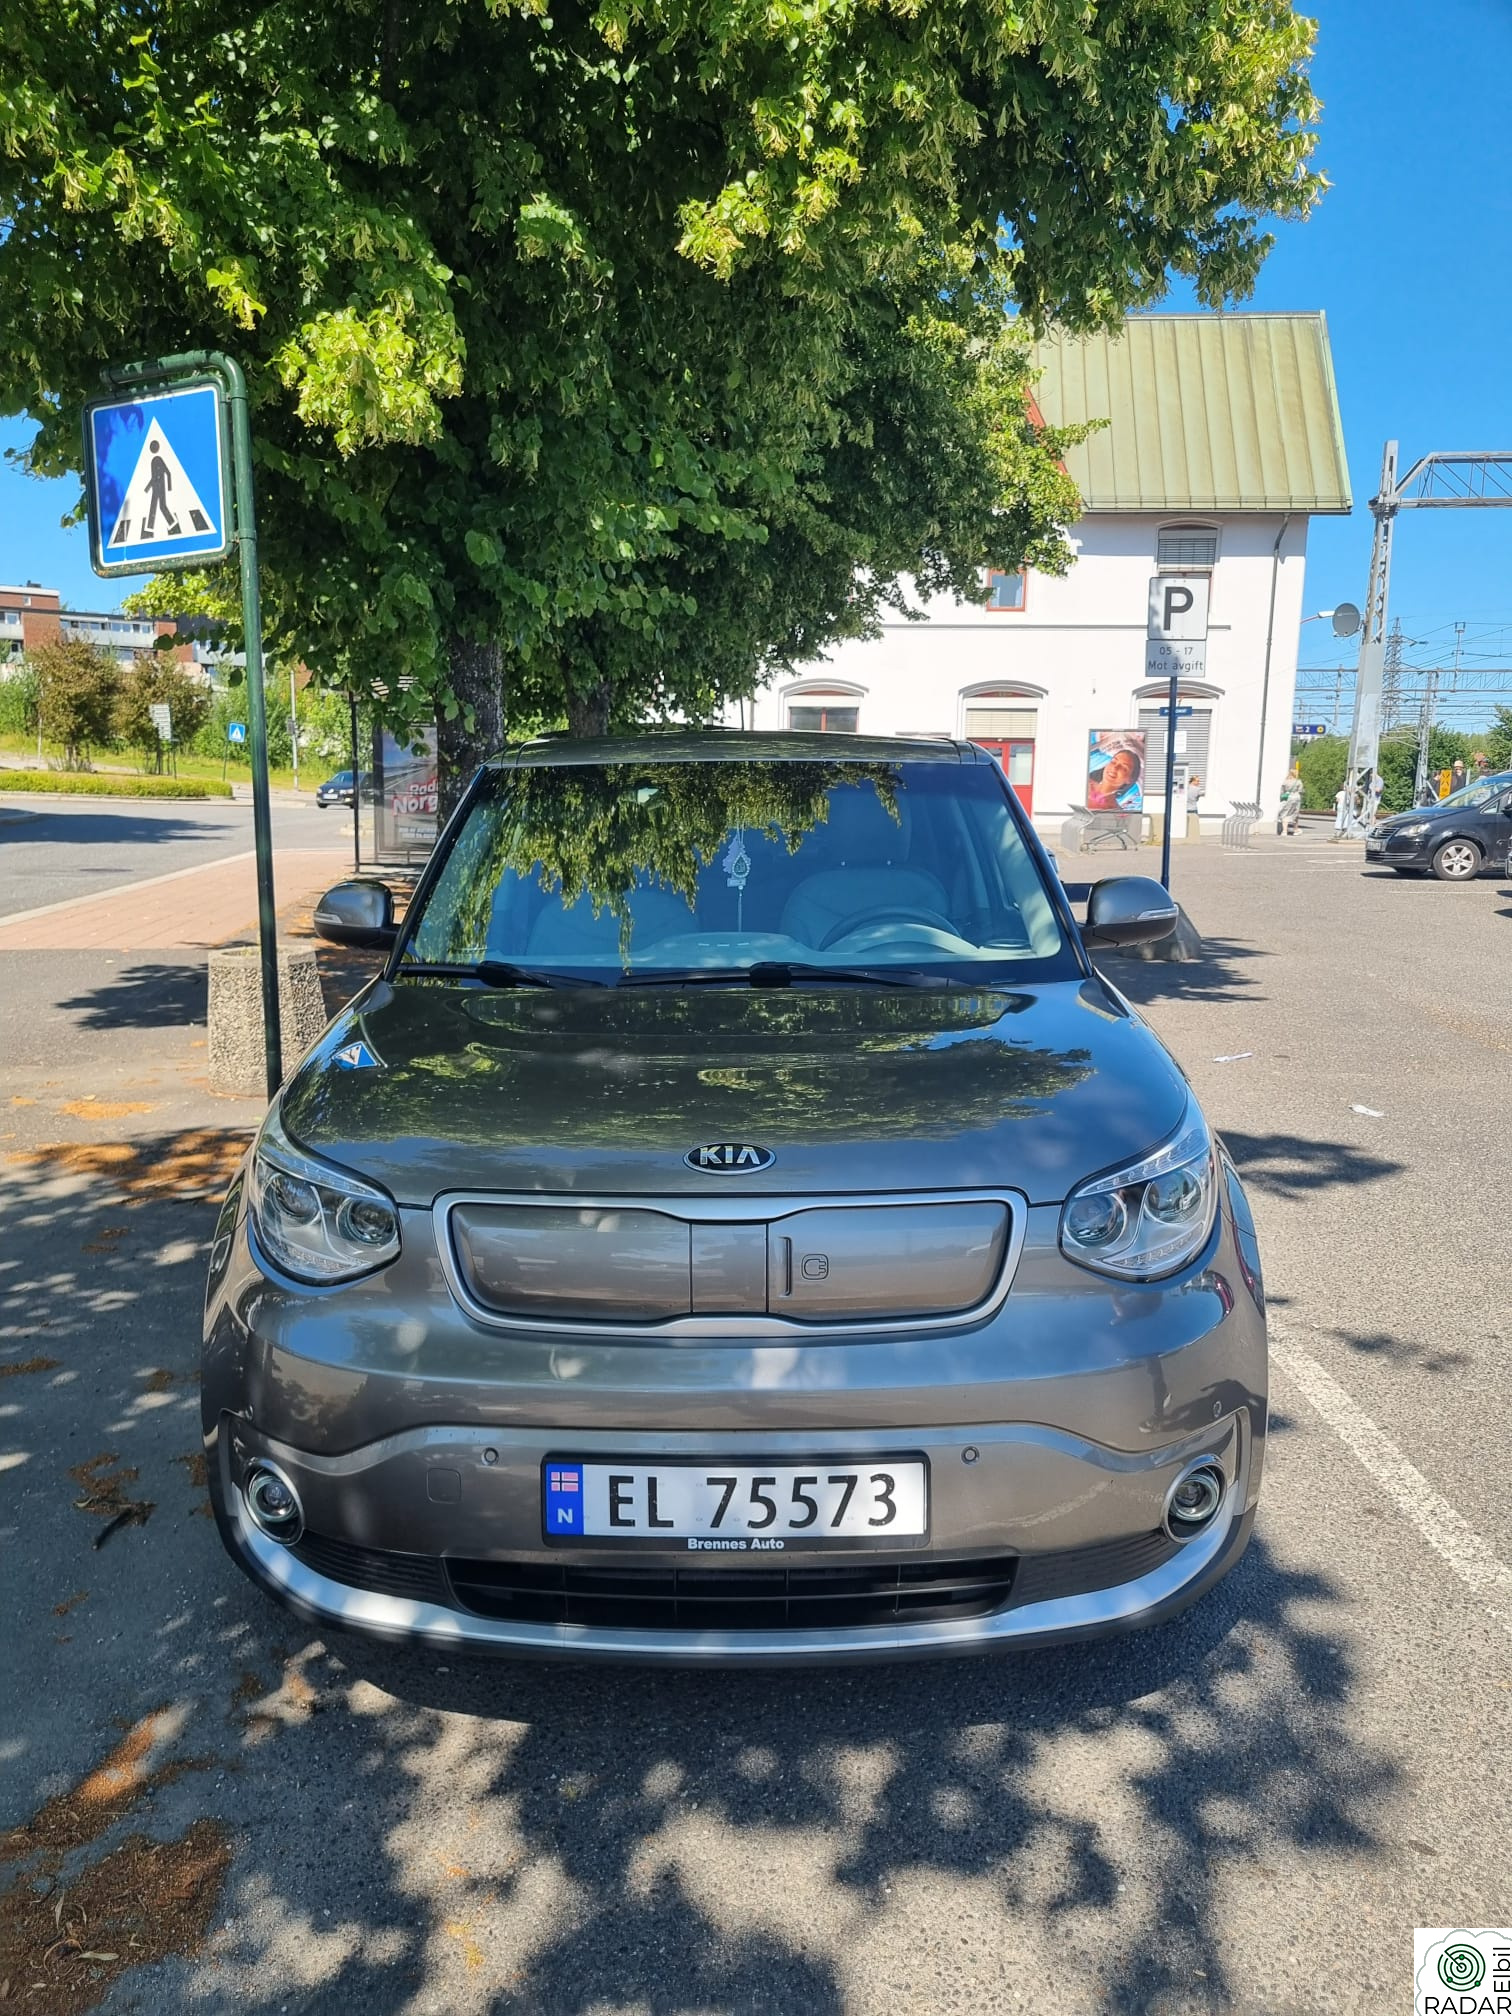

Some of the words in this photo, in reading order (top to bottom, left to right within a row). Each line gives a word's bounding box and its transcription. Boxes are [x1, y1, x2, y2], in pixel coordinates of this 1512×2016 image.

[1163, 586, 1194, 631] P
[1159, 647, 1172, 655] 05
[1184, 647, 1193, 655] 17
[1148, 660, 1168, 671] Mot
[1172, 660, 1203, 673] avgift
[410, 779, 439, 796] Rad
[699, 1146, 761, 1165] KIA
[608, 1474, 674, 1528] EL
[706, 1473, 897, 1529] 75573
[557, 1507, 573, 1524] N
[687, 1537, 748, 1550] Brennes
[752, 1537, 784, 1550] Auto
